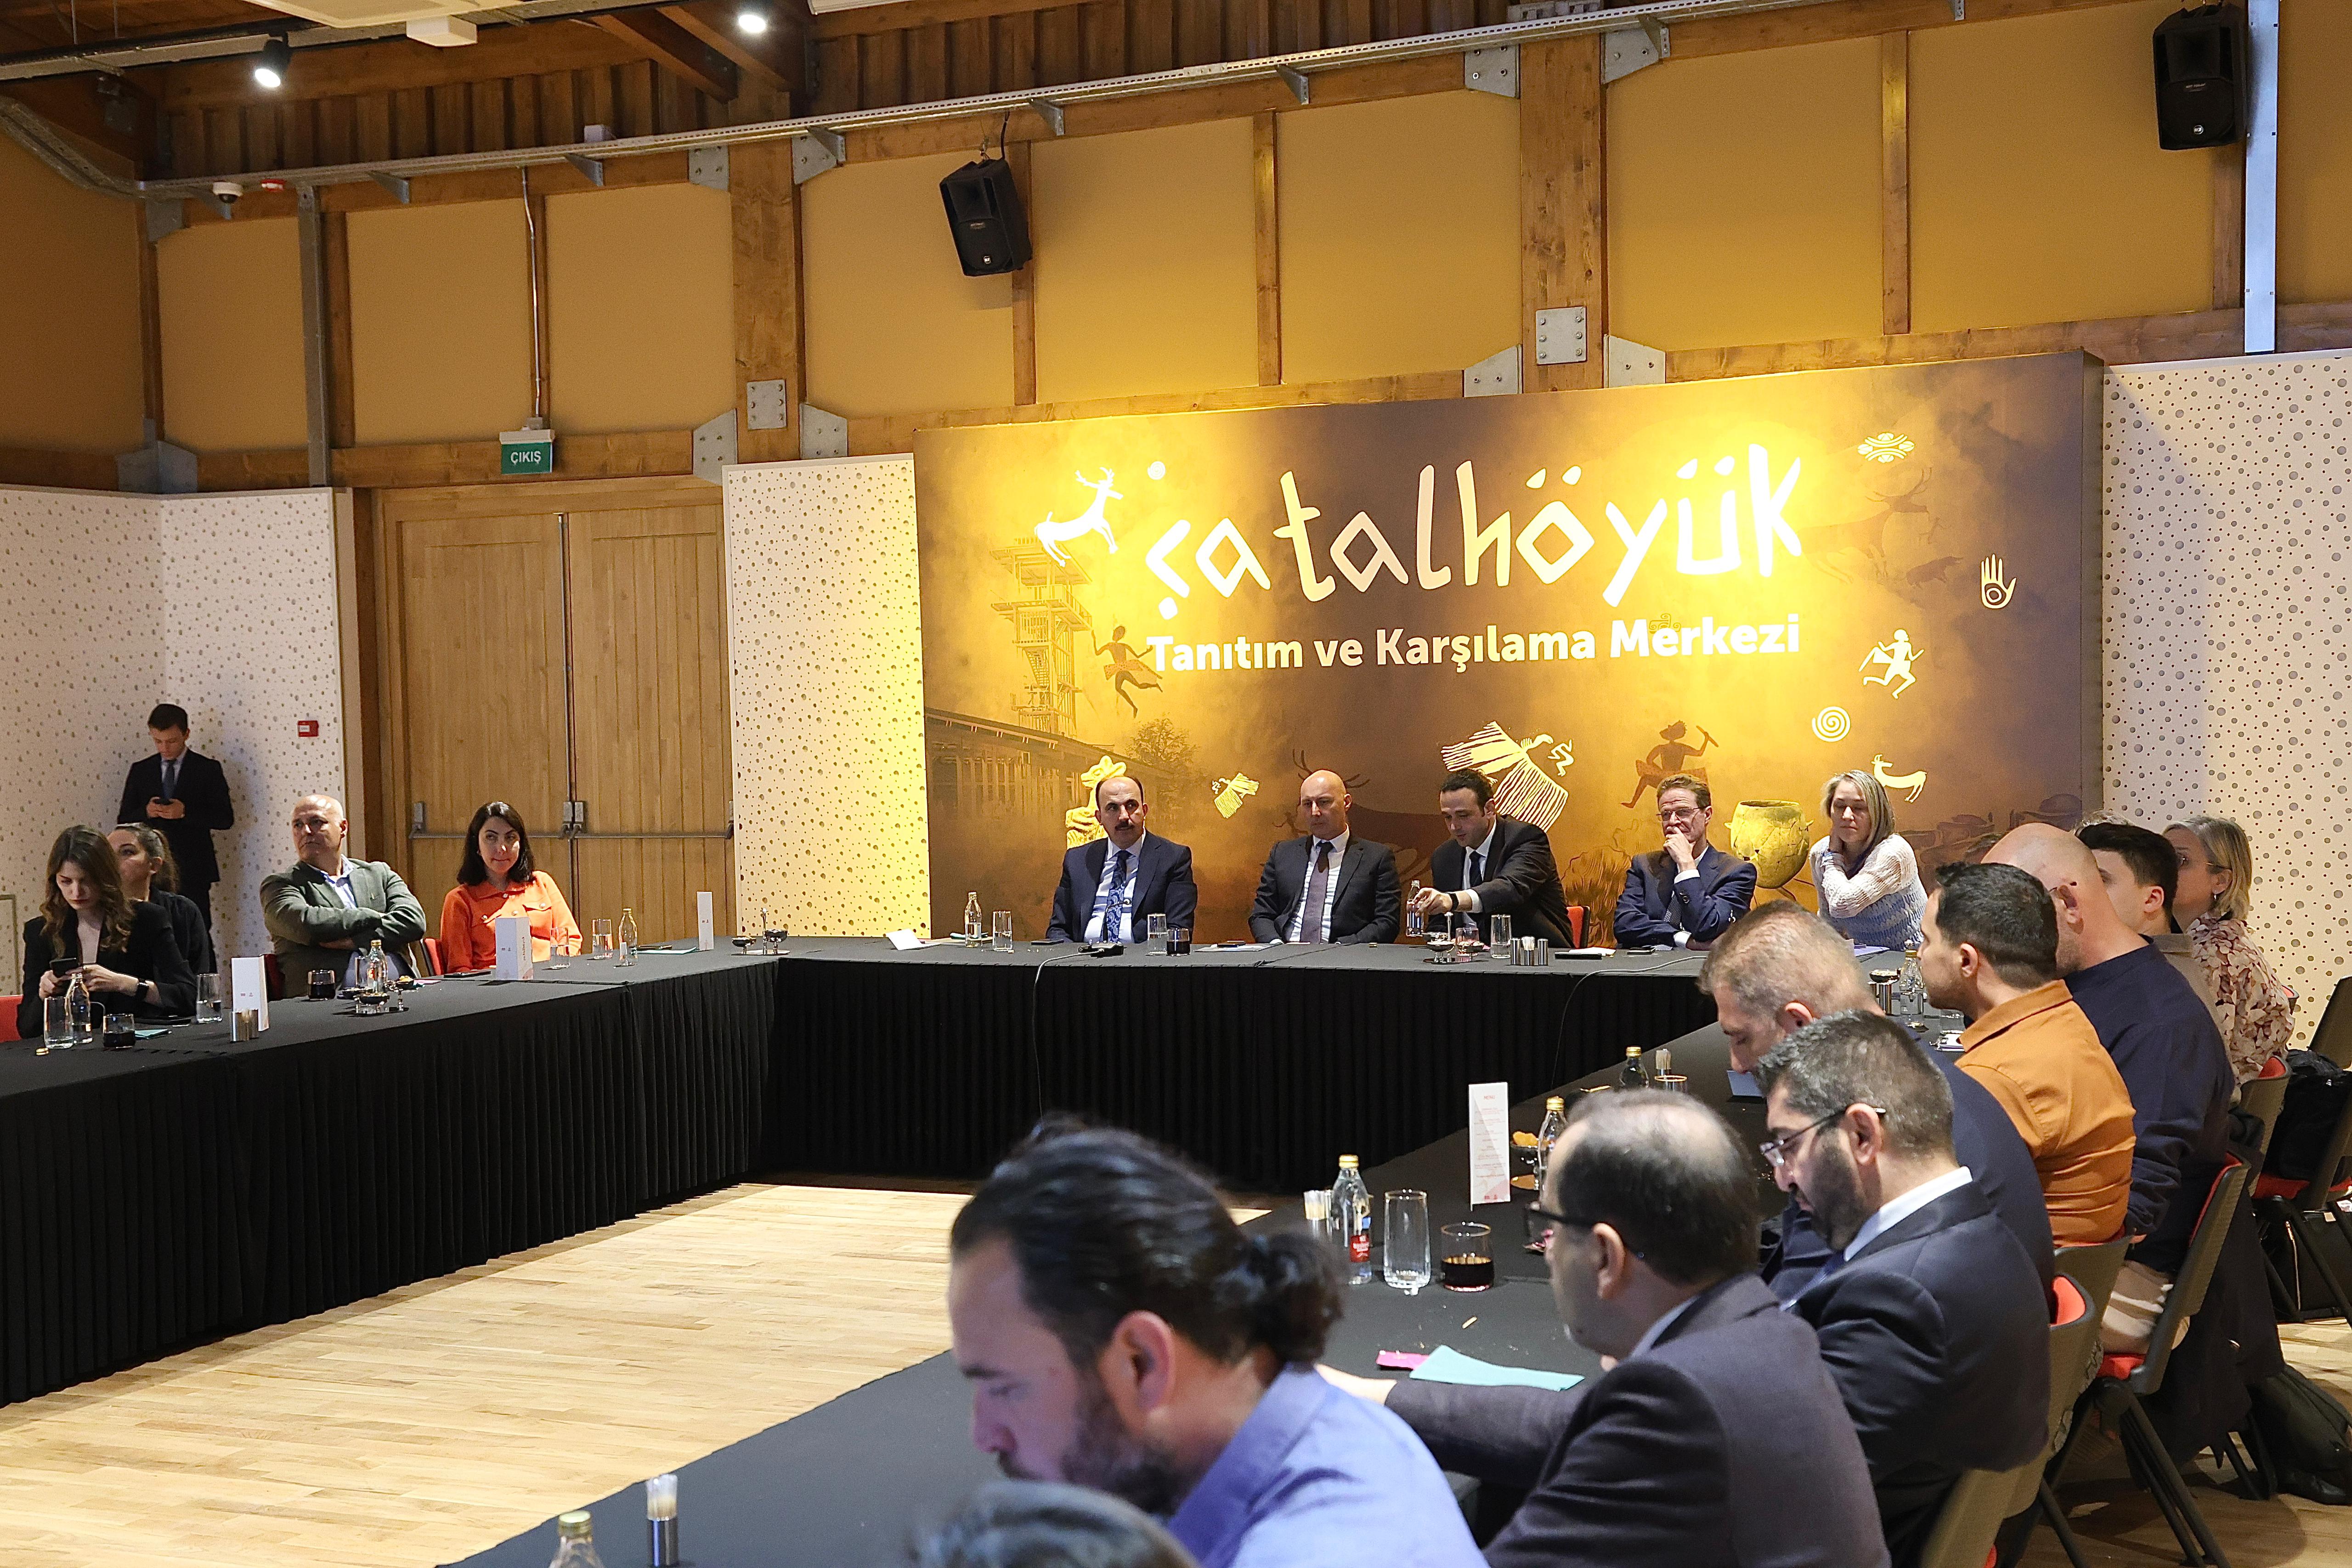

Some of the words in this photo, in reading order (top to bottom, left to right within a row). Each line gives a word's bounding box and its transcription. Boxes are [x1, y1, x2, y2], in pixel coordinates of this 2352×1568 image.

[510, 451, 541, 465] ÇIKIŞ
[1145, 443, 1802, 620] çatalhöyük
[1146, 635, 1303, 671] Tanıtım
[1313, 639, 1363, 667] ve
[1376, 625, 1595, 673] Karşılama
[1610, 613, 1799, 658] Merkezi
